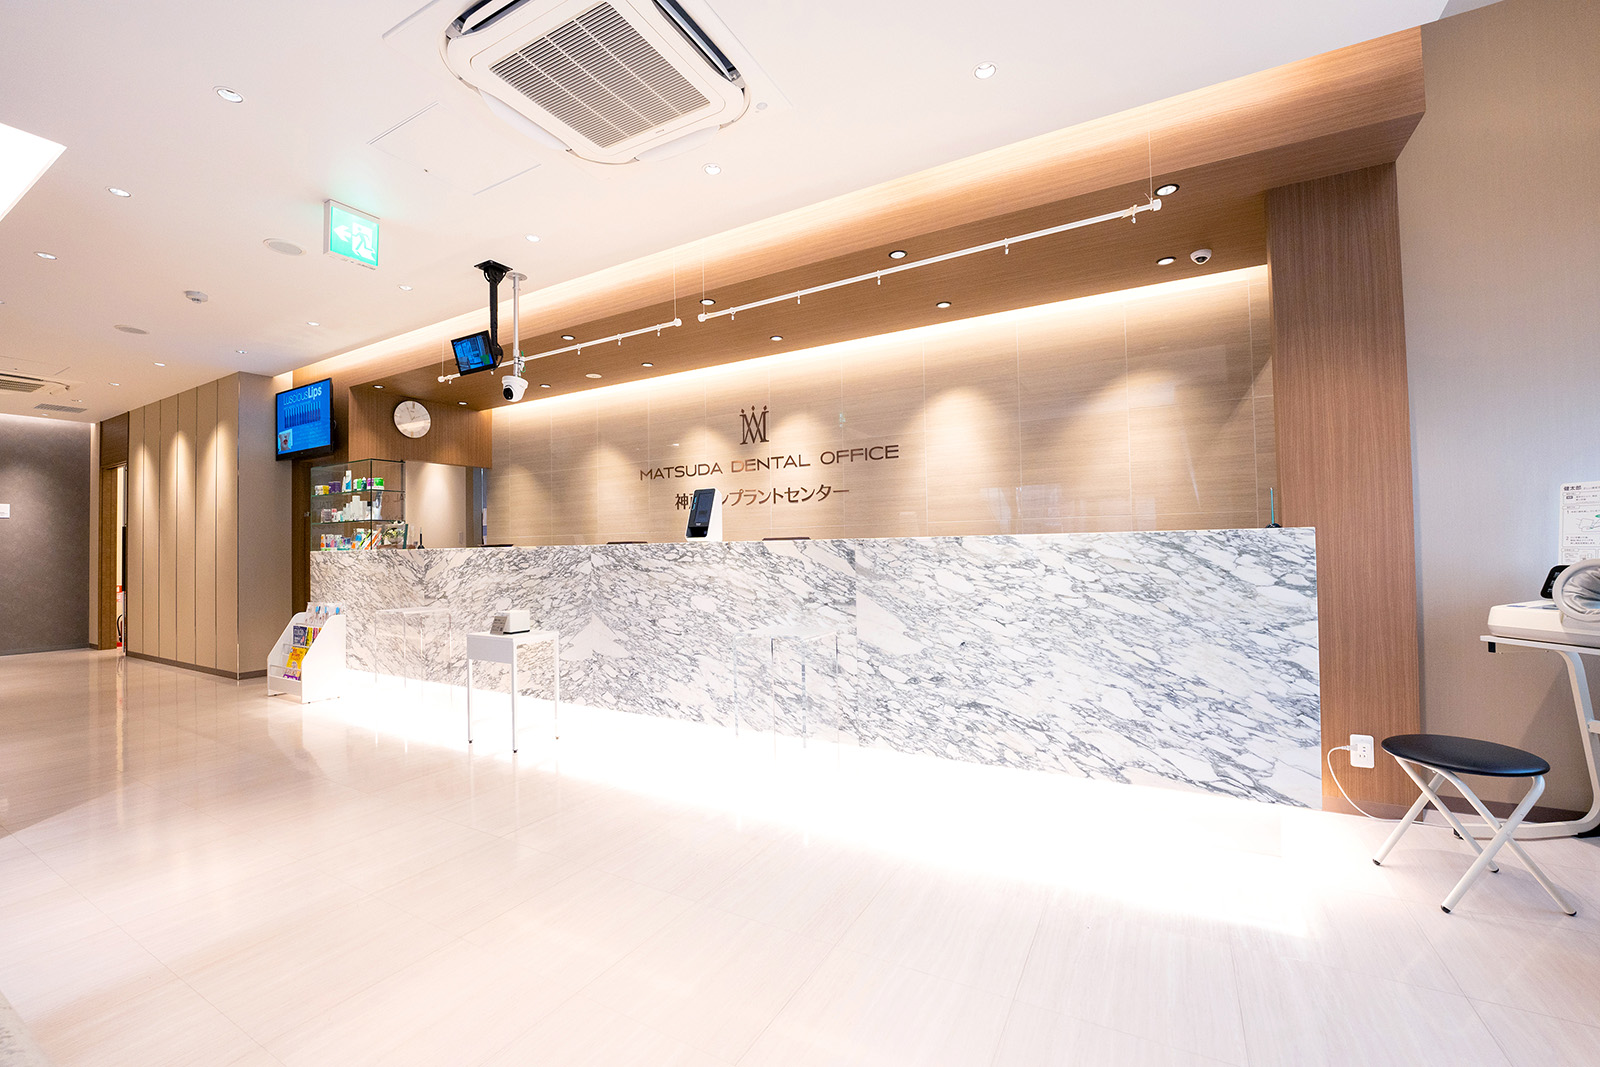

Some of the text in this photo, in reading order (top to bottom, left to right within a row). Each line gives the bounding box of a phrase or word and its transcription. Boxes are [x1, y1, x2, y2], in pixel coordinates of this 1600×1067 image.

[640, 445, 899, 481] MATSUDA DENTAL OFFICE
